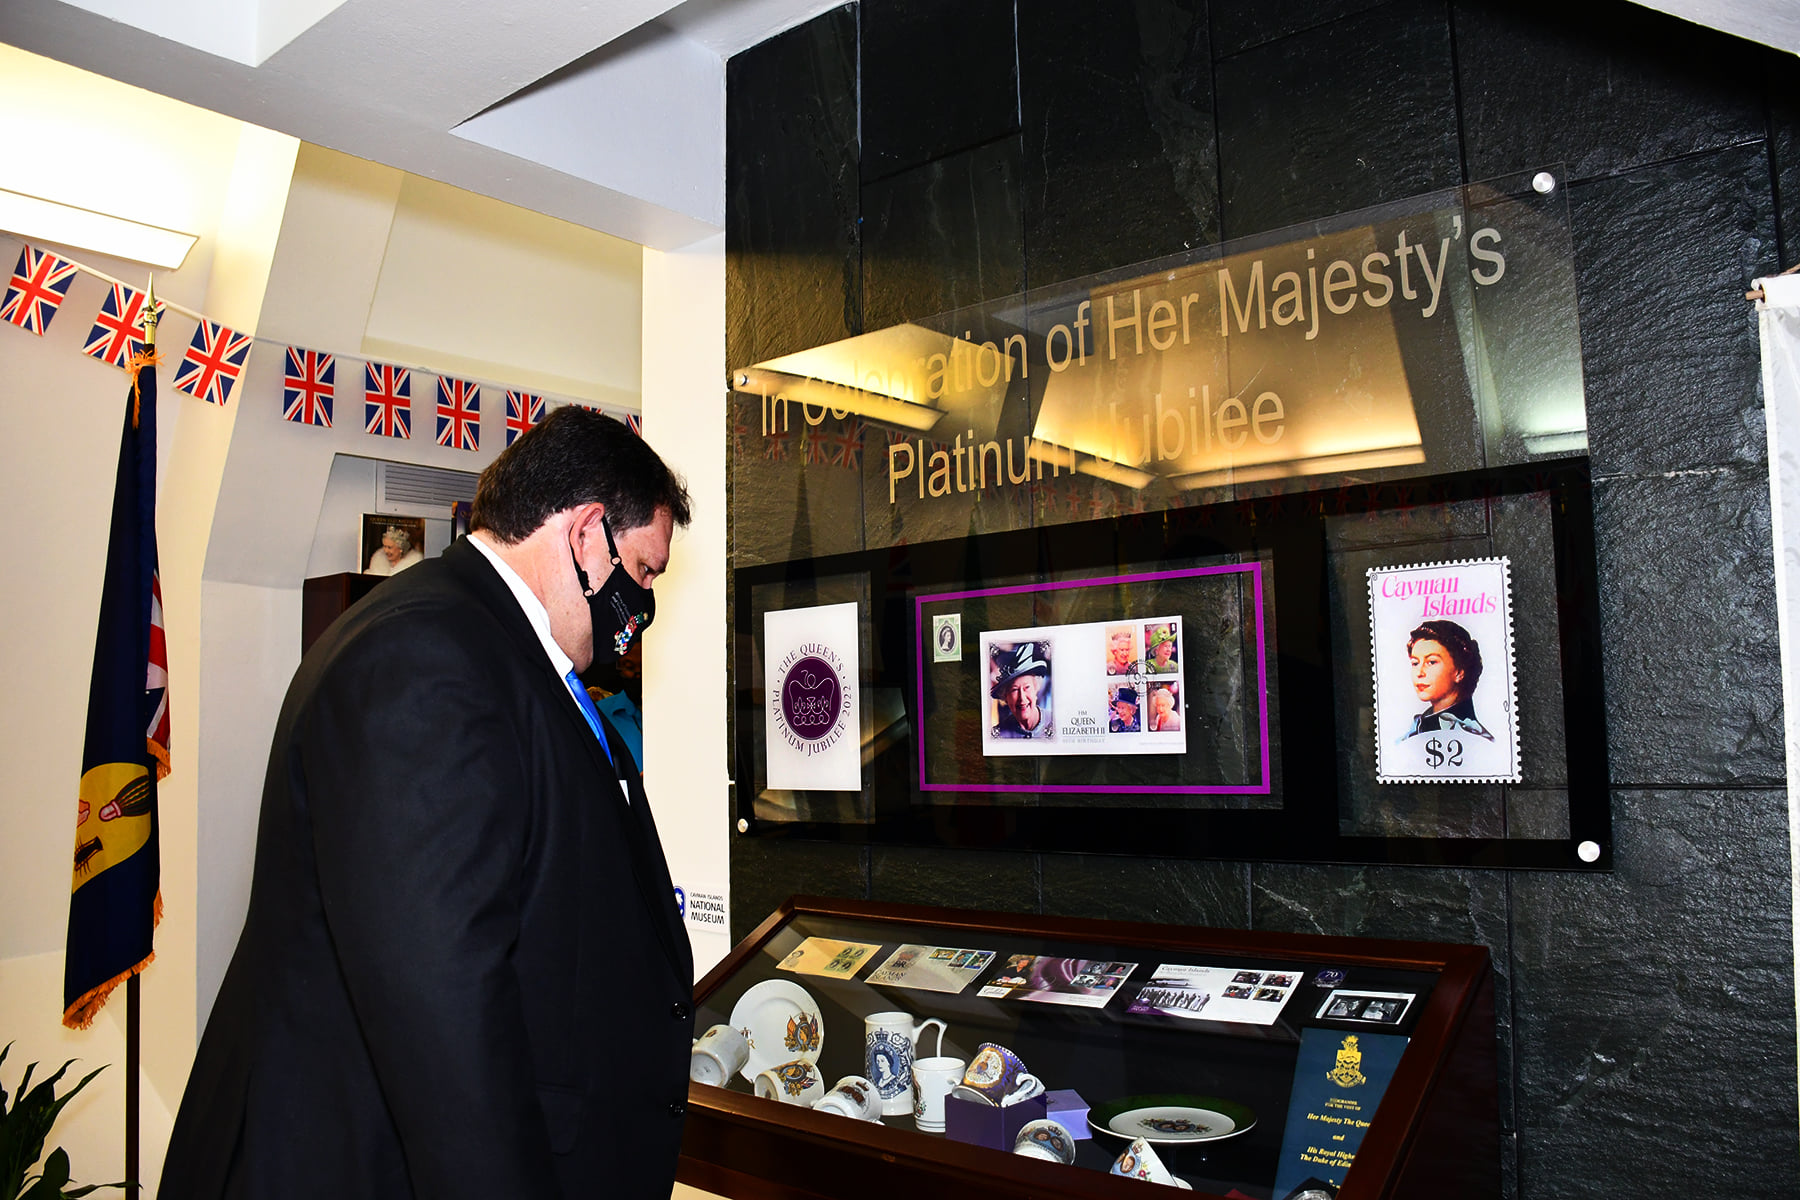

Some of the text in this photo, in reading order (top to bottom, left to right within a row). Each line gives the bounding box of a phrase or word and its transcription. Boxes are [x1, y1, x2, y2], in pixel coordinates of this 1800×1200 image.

[762, 384, 789, 437] In
[1045, 300, 1091, 372] of
[1107, 289, 1199, 361] Her
[889, 385, 1285, 504] Platinum Jubilee
[1382, 574, 1459, 600] Cayman
[1422, 592, 1497, 617] Islands
[778, 650, 798, 674] THE
[773, 685, 852, 757] PLATINUM JUBILEE 2022
[1070, 717, 1096, 727] QUEEN
[1062, 727, 1099, 735] ELIZABETH
[1425, 736, 1464, 770] $2
[690, 900, 725, 913] NATIONAL
[691, 911, 725, 924] MUSEUM
[1307, 1113, 1319, 1121] Her
[1320, 1114, 1343, 1125] Majesty
[1344, 1117, 1355, 1126] The
[1332, 1134, 1346, 1142] and
[1307, 1146, 1318, 1154] His
[1318, 1148, 1337, 1157] Royal
[1300, 1153, 1312, 1162] The
[1312, 1156, 1329, 1165] Duke
[1329, 1159, 1338, 1167] of
